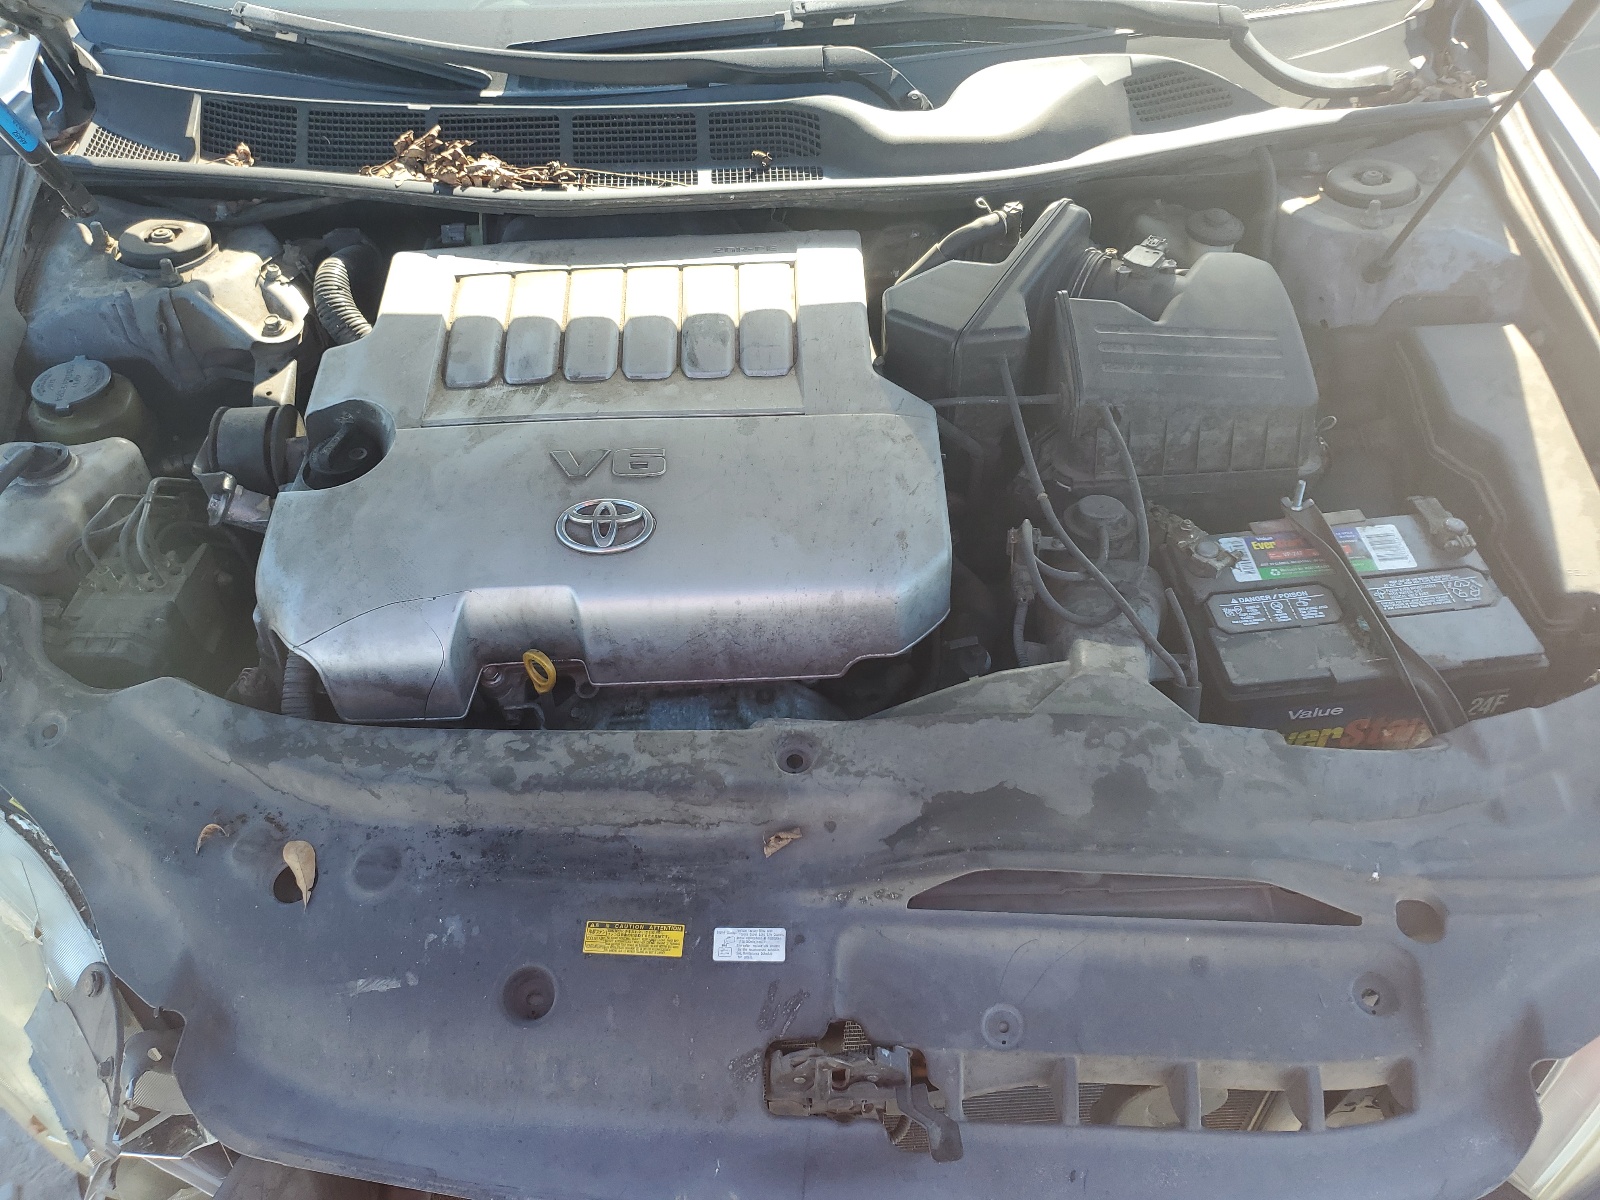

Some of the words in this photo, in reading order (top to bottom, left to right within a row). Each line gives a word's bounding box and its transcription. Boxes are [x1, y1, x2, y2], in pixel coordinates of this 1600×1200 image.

[549, 447, 667, 478] V6
[1238, 594, 1271, 603] DANGER
[1277, 590, 1308, 599] POISON
[1288, 706, 1344, 720] Value
[1468, 694, 1510, 717] 24F
